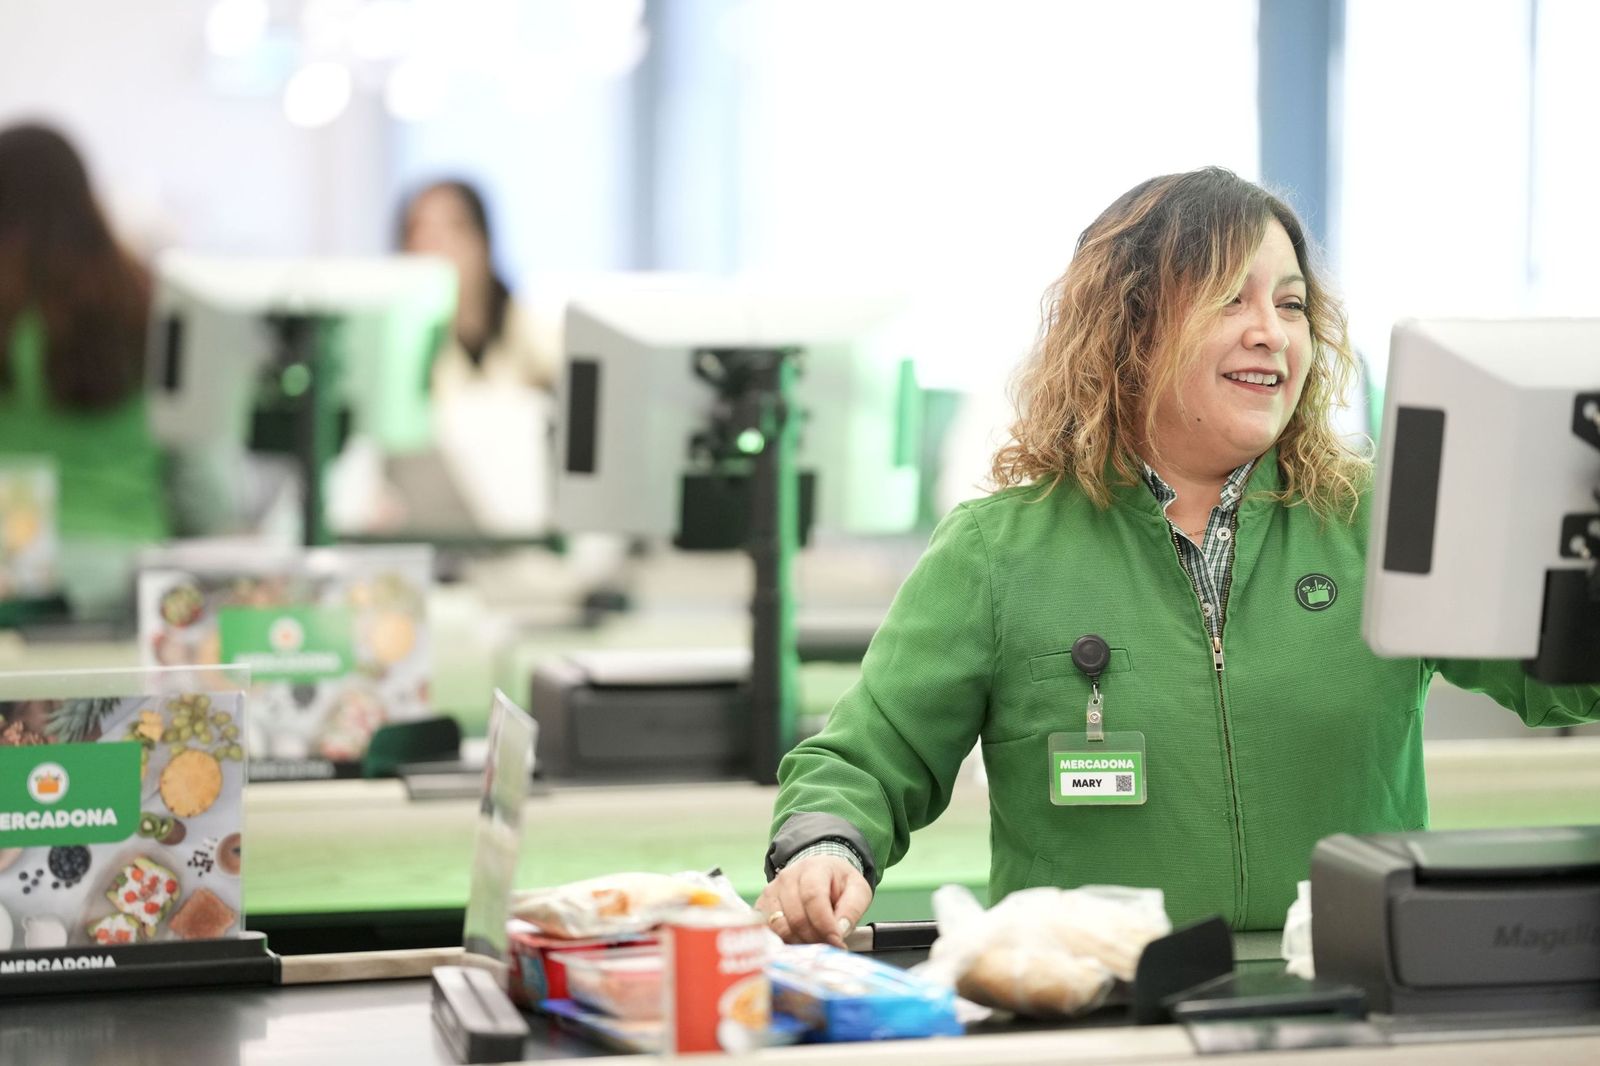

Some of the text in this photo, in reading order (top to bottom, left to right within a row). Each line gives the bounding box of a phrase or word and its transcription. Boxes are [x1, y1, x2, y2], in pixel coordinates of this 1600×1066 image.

[1060, 759, 1134, 769] MERCADONA
[1072, 779, 1102, 788] MARY
[0, 808, 117, 830] ERCADONA
[0, 955, 116, 974] MERCADONA
